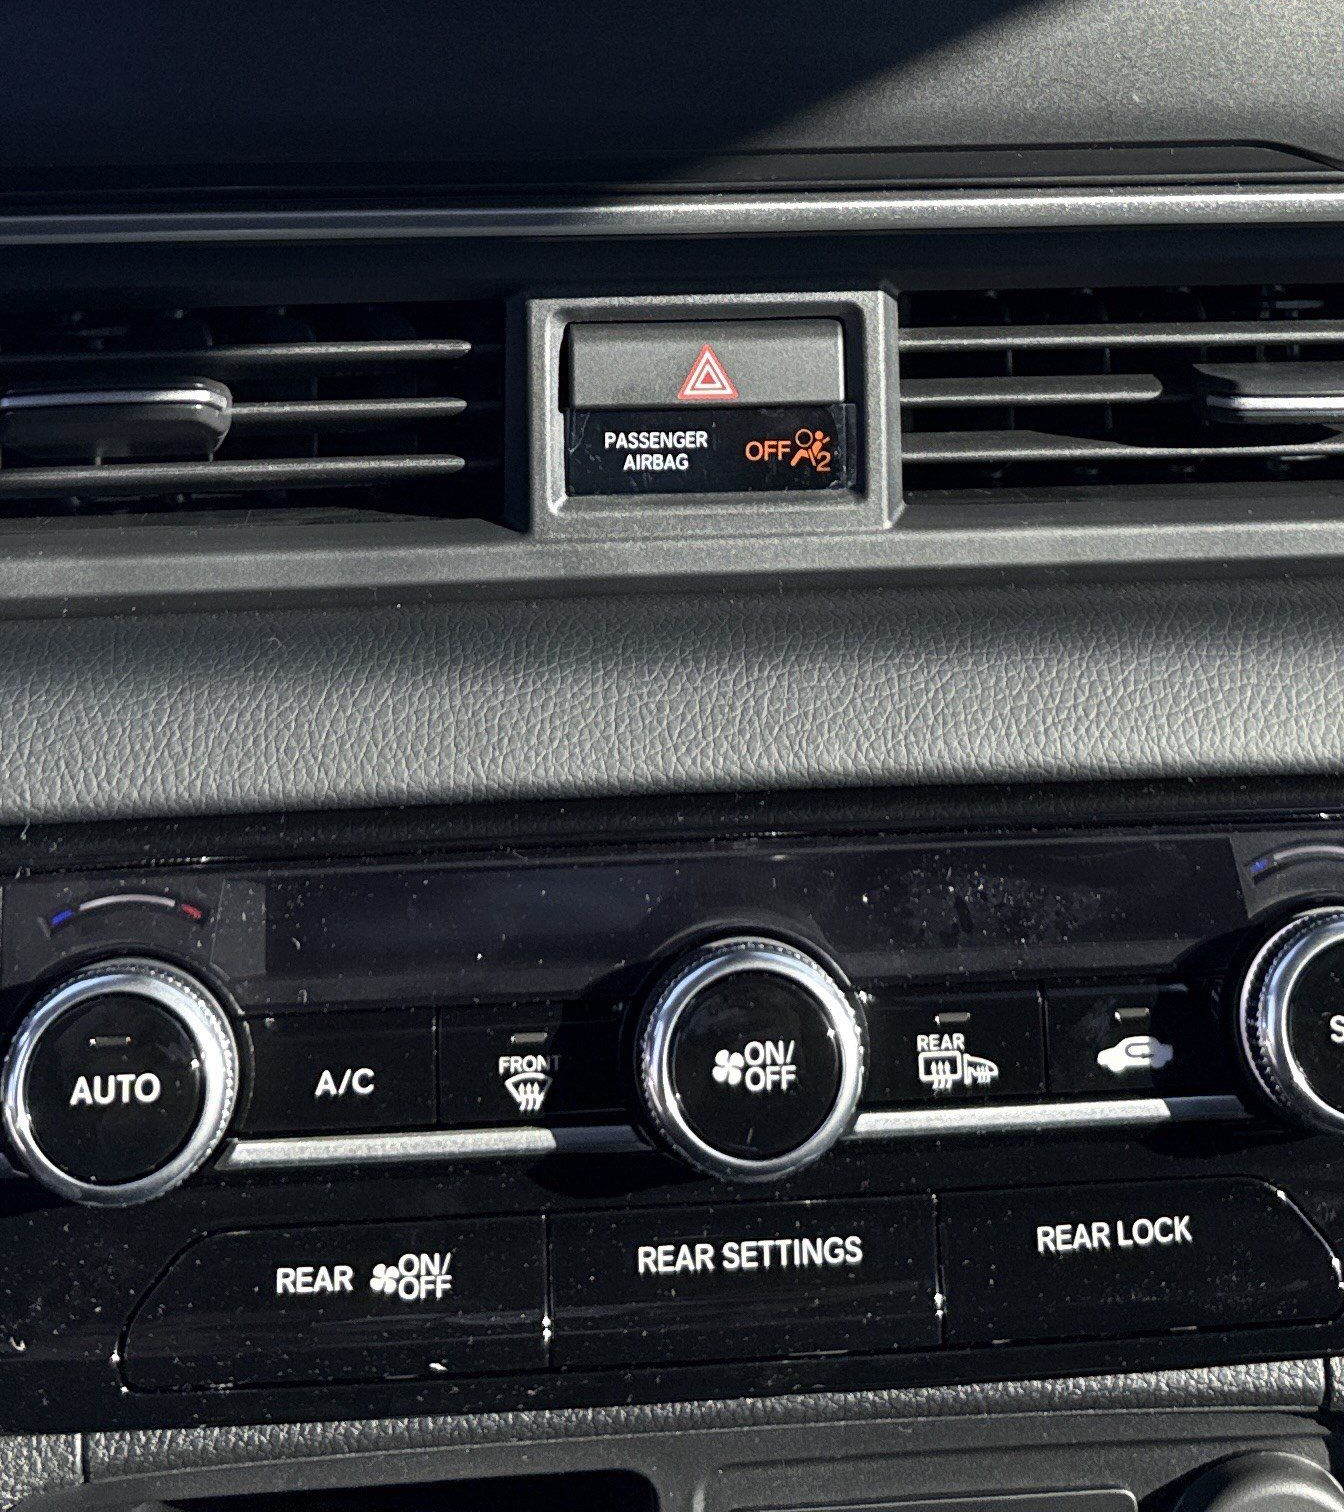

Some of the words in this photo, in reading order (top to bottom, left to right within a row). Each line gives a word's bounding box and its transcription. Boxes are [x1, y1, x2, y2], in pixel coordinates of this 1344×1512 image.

[604, 430, 708, 450] PASSENGER
[745, 440, 792, 462] OFF
[622, 453, 689, 471] AIRBAG
[744, 1039, 796, 1069] ON/
[916, 1033, 965, 1053] REAR
[498, 1054, 562, 1075] FRONT
[70, 1071, 162, 1106] AUTO
[314, 1068, 376, 1098] A/C
[745, 1065, 798, 1092] OFF
[1036, 1222, 1112, 1256] REAR
[1117, 1216, 1193, 1251] LOCK
[398, 1252, 452, 1279] ON/
[637, 1243, 716, 1275] REAR
[721, 1236, 864, 1272] SETTINGS
[275, 1264, 354, 1295] REAR
[398, 1275, 452, 1302] OFF
